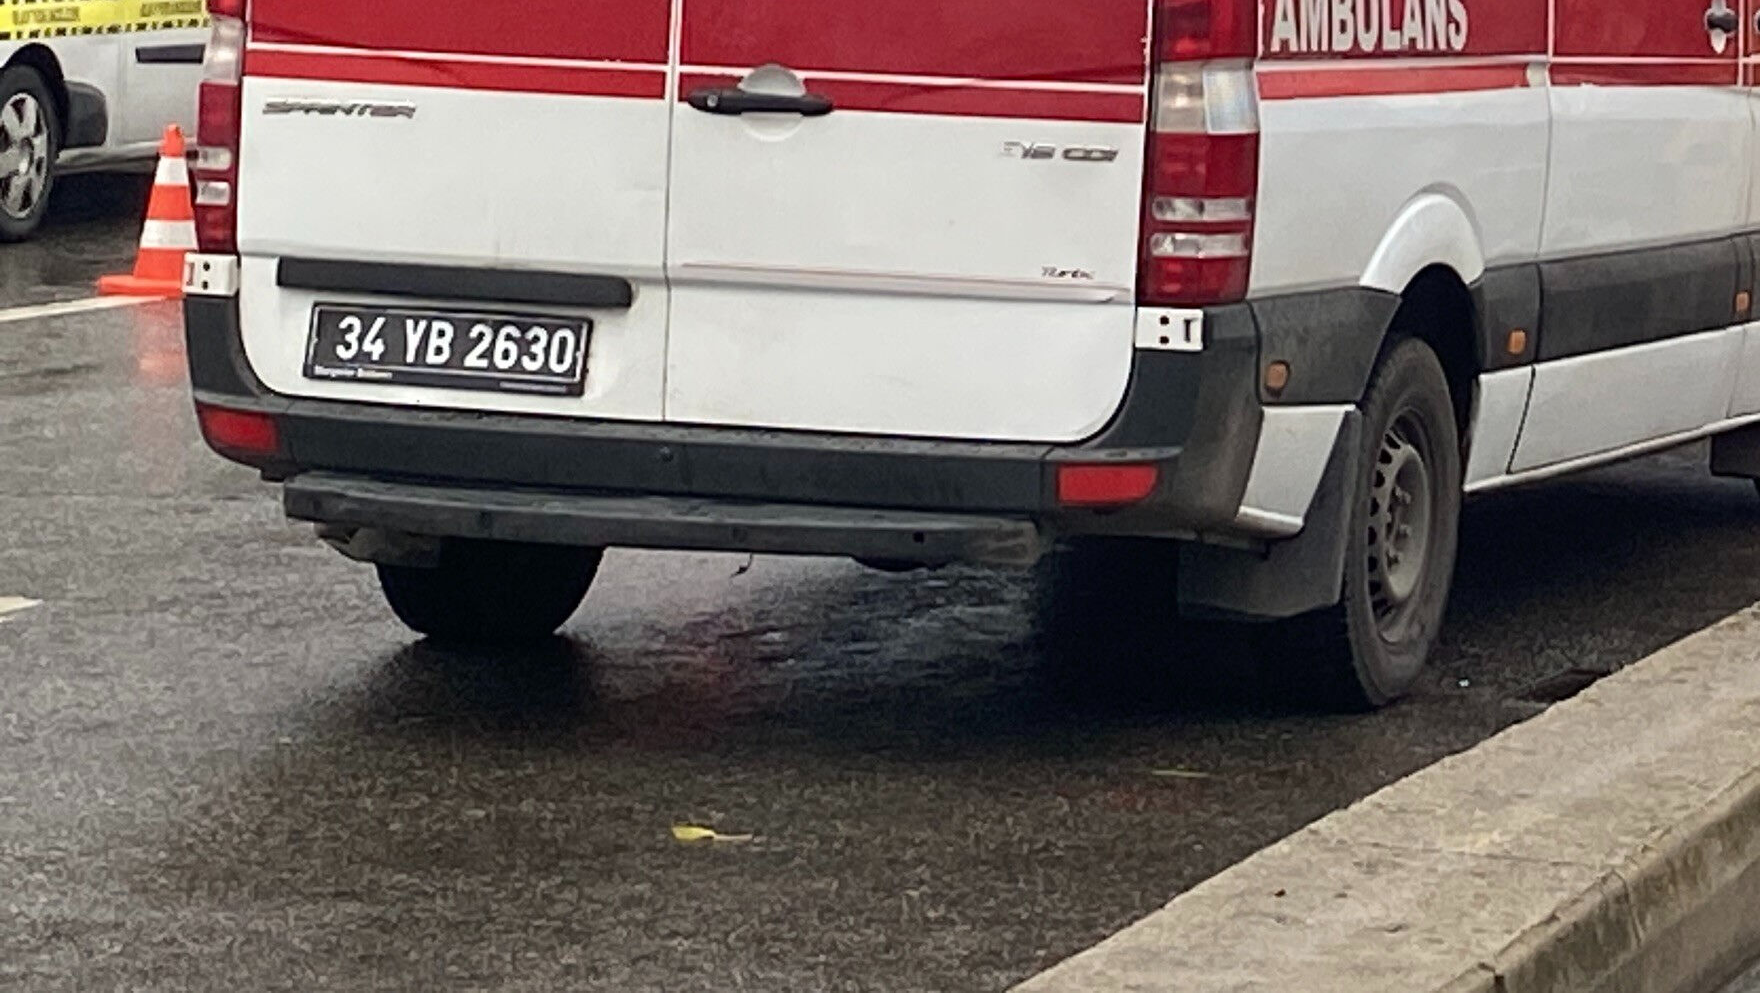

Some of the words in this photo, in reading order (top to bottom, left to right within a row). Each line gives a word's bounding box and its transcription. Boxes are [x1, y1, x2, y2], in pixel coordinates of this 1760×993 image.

[336, 315, 387, 362] 34
[403, 318, 454, 366] YB
[464, 322, 575, 374] 2630
